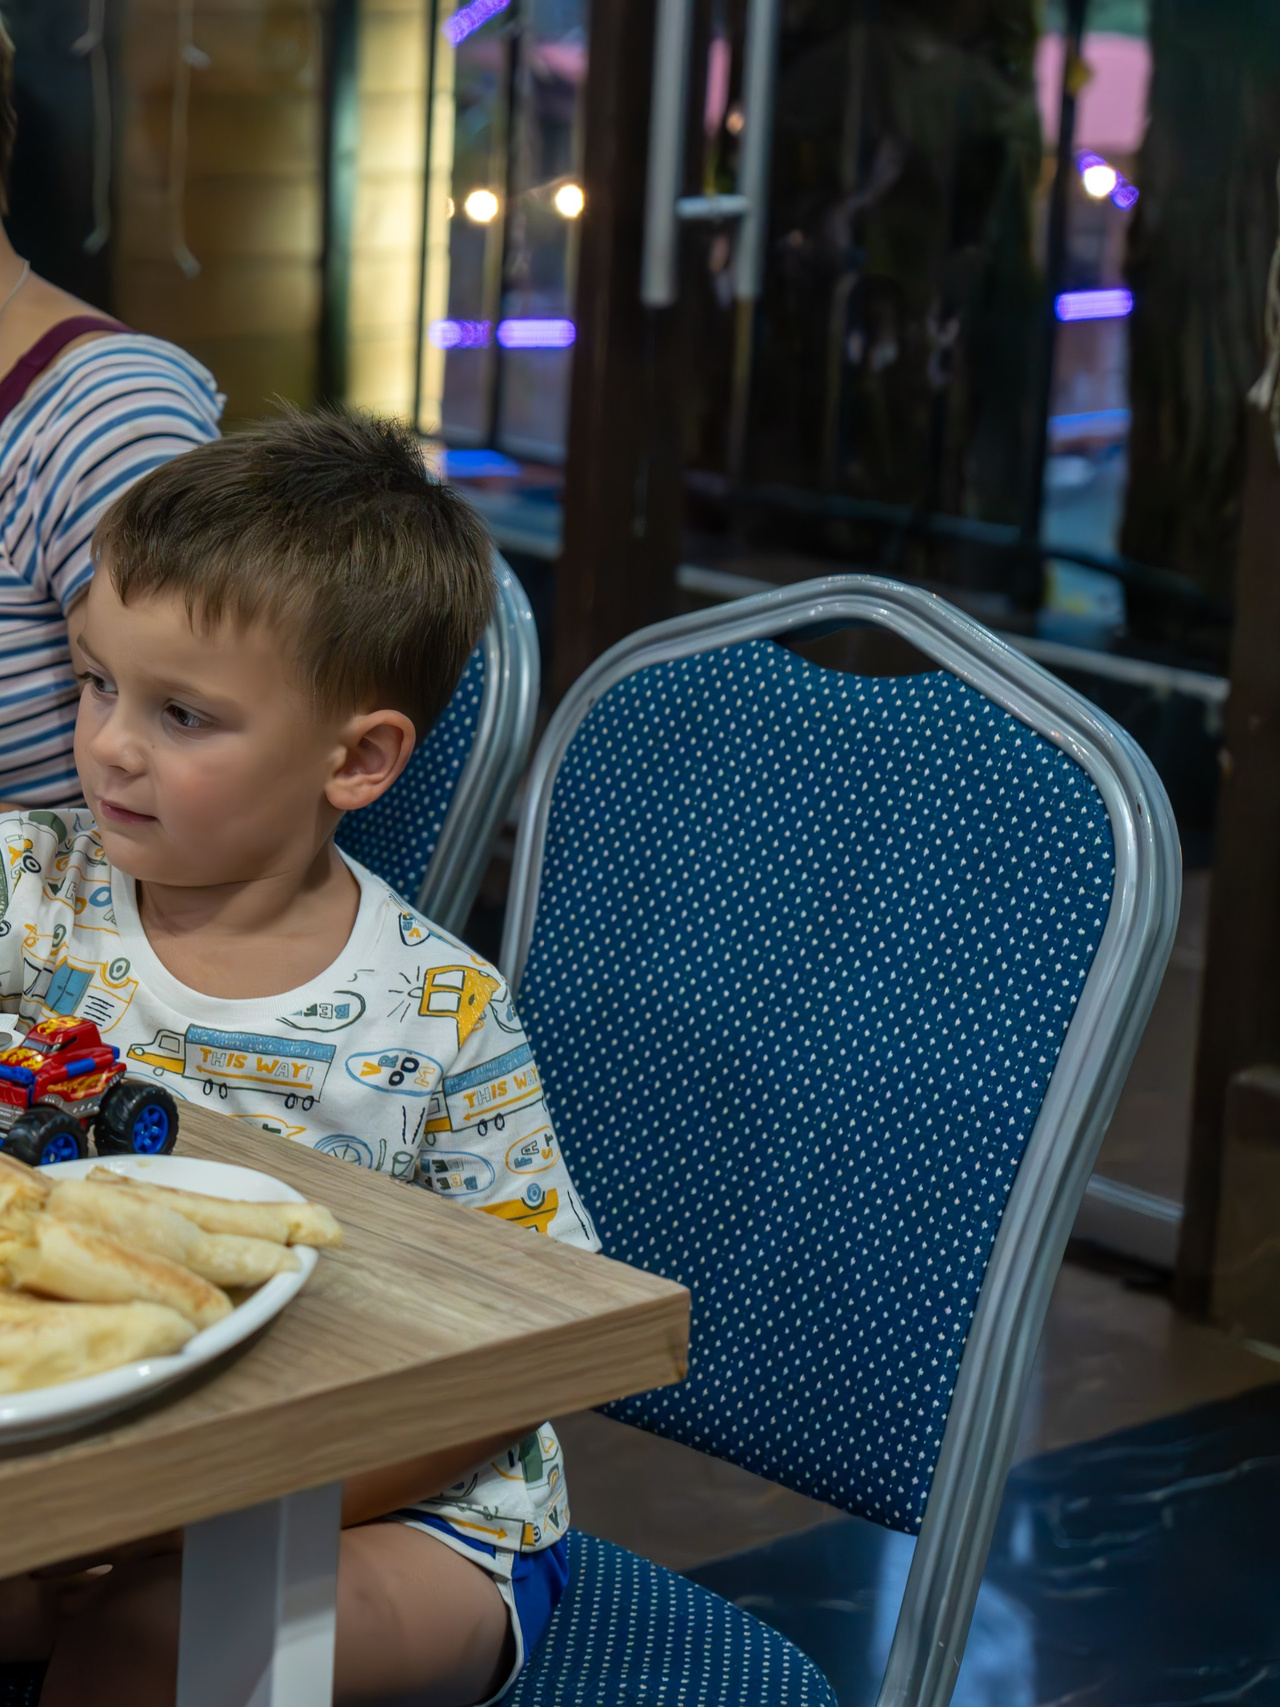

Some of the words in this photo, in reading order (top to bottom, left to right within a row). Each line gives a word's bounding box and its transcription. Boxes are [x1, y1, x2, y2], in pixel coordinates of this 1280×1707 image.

[290, 1003, 350, 1019] BEE
[199, 1047, 249, 1070] THIS
[255, 1056, 314, 1082] WAY!
[360, 1054, 436, 1088] VROOM
[462, 1080, 508, 1109] THIS
